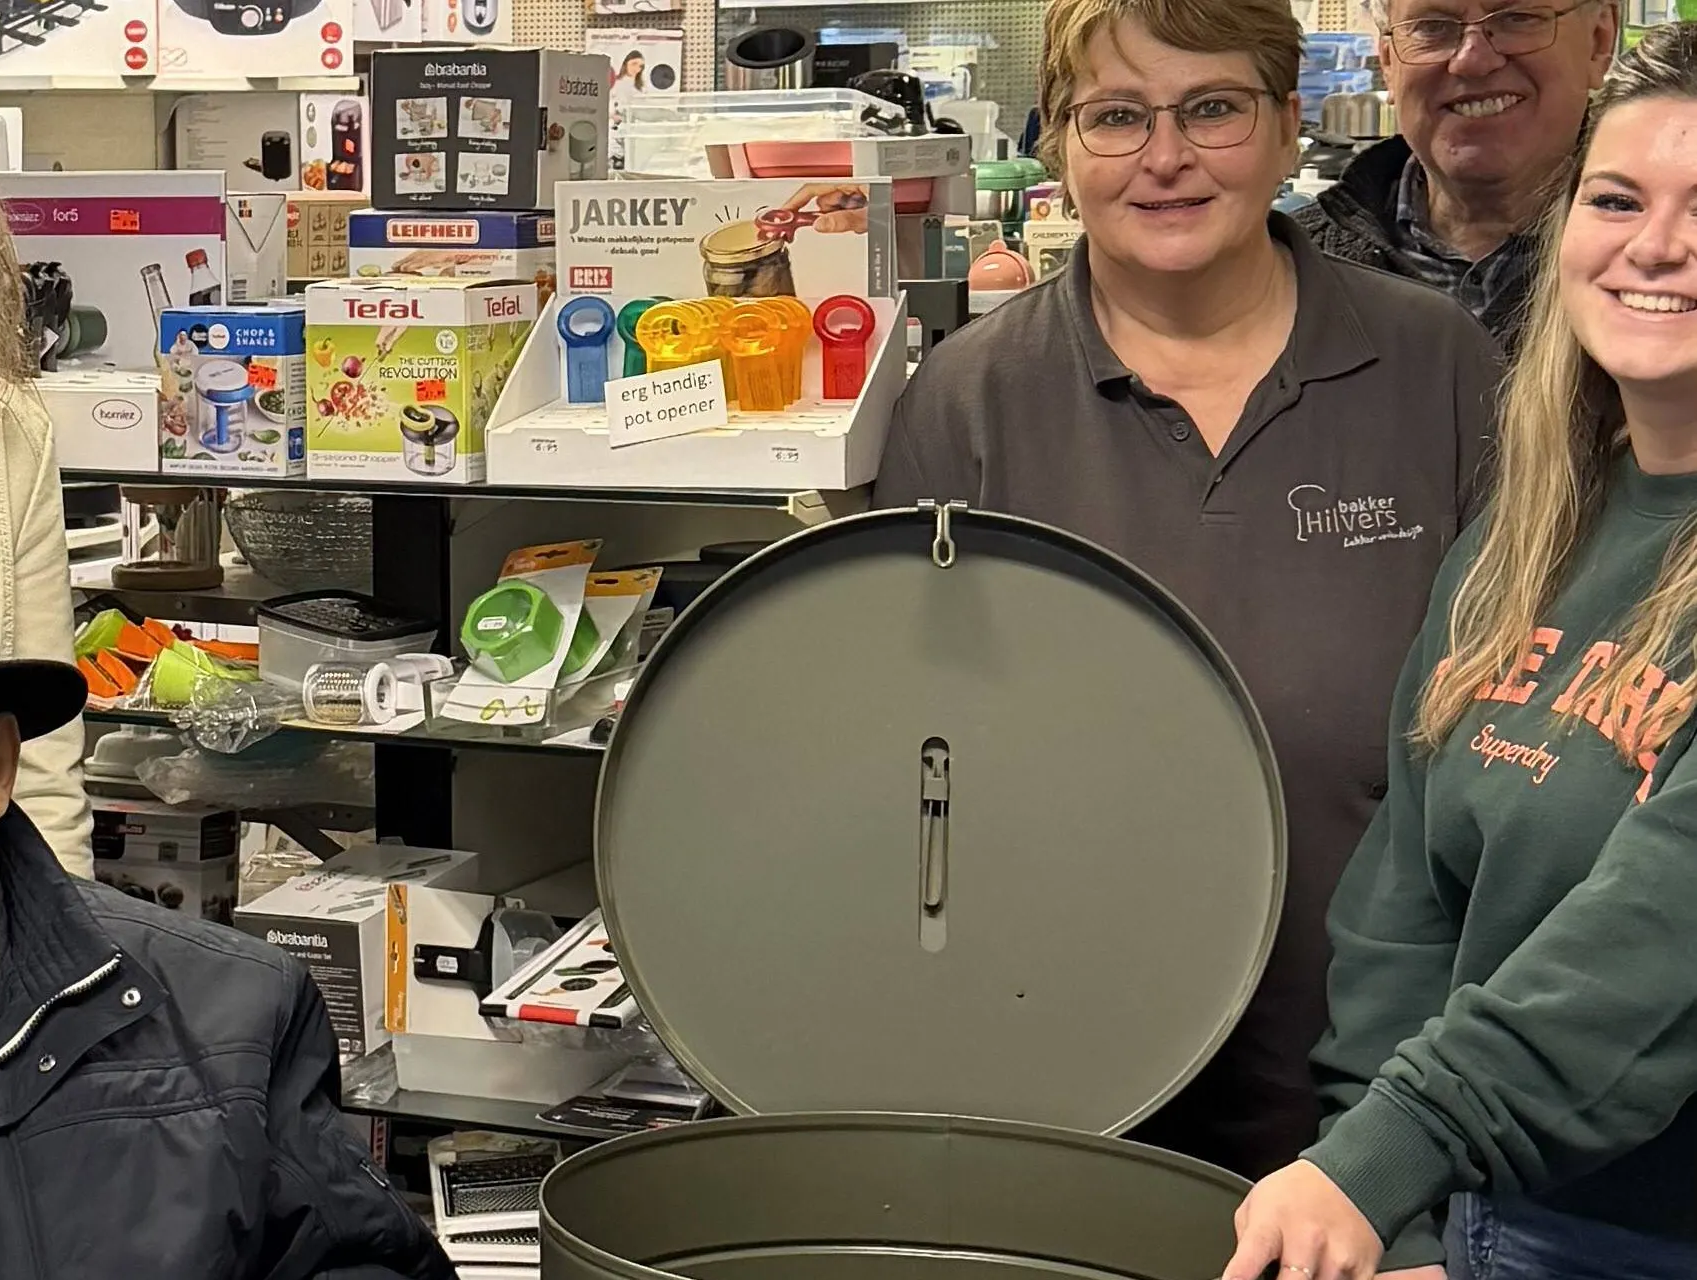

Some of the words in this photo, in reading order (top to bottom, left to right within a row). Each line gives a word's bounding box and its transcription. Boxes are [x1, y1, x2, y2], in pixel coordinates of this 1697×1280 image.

[435, 62, 487, 77] brabantia
[565, 77, 599, 97] brabantia
[569, 198, 690, 234] JARKEY
[391, 223, 475, 238] LEIFHEIT
[573, 268, 608, 286] BRIX
[343, 298, 425, 319] Tefal
[484, 295, 523, 318] Tefal
[417, 357, 457, 366] CUTTING
[379, 367, 458, 379] REVOLUTION
[621, 386, 649, 402] erg
[652, 372, 713, 396] handig:
[624, 410, 653, 430] pot
[657, 399, 715, 421] opener
[1338, 496, 1395, 514] bakker
[1305, 507, 1398, 534] Hilvers
[1470, 723, 1561, 785] Superdry
[278, 931, 329, 948] brabantia
